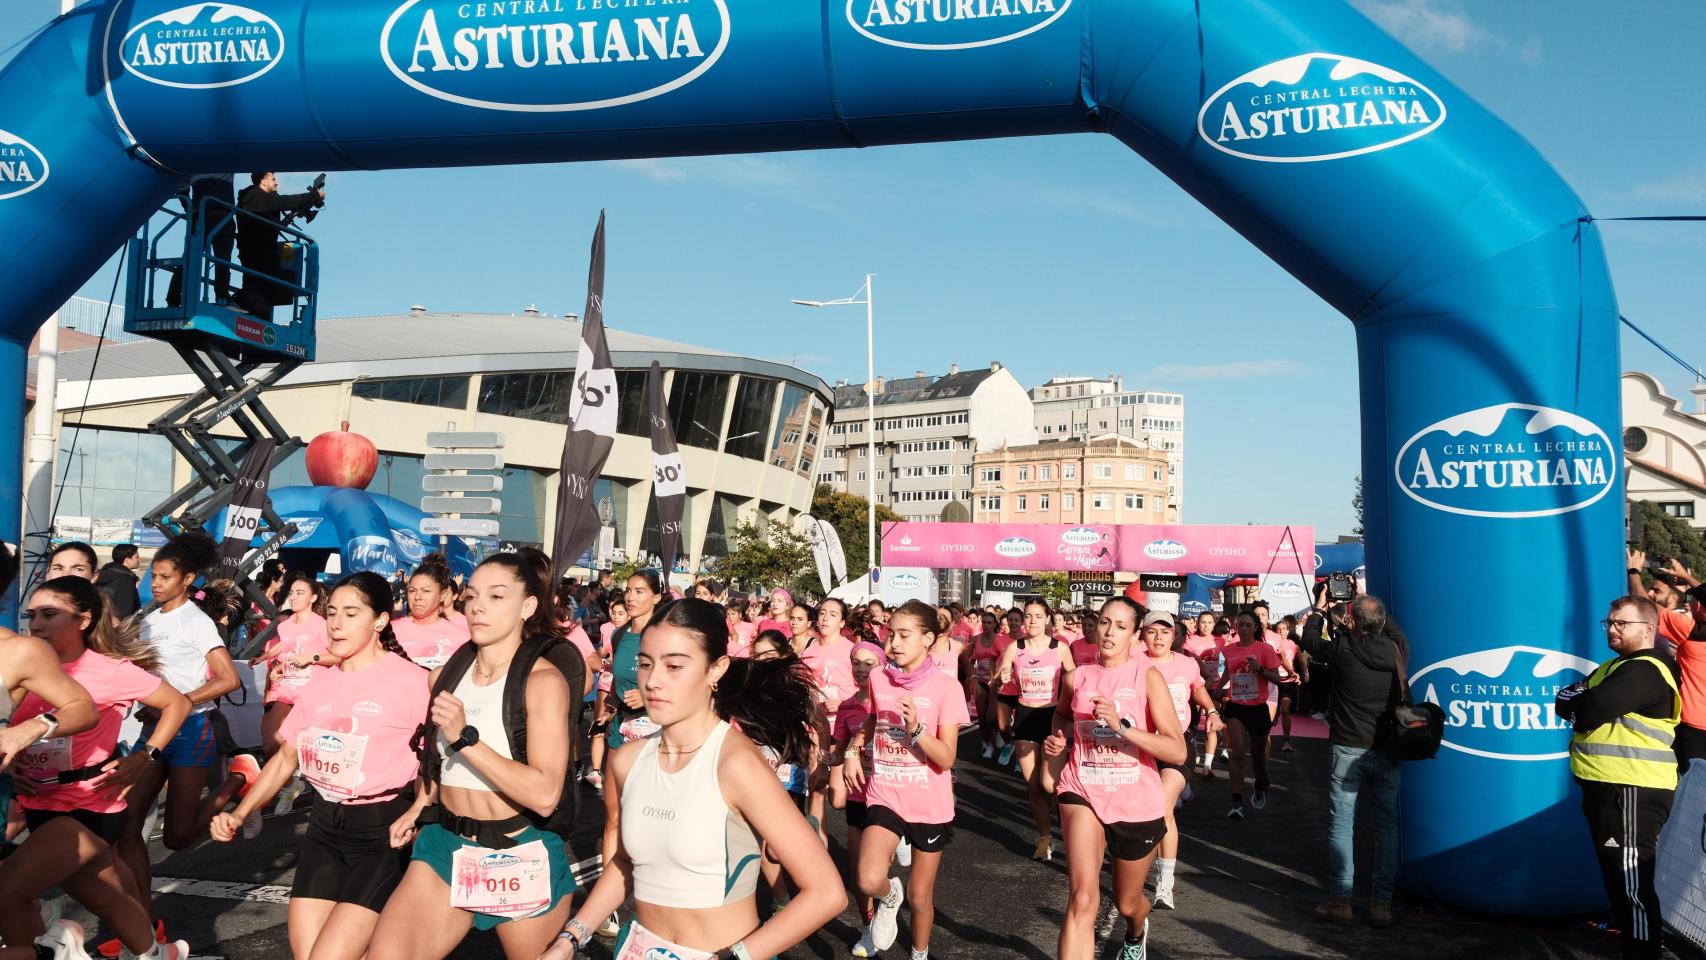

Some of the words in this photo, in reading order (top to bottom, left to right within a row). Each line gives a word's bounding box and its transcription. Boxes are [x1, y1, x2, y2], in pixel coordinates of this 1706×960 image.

[459, 0, 564, 18] CENTRAL
[157, 28, 208, 39] CENTRAL
[213, 26, 267, 36] LECHERA
[408, 9, 705, 72] ASTURIANA
[131, 32, 272, 66] ASTURIANA
[1250, 88, 1331, 106] CENTRAL
[1339, 86, 1418, 98] LECHERA
[1217, 100, 1432, 142] ASTURIANA
[1444, 442, 1525, 455] CENTRAL
[1534, 440, 1601, 452] LECHERA
[1410, 448, 1607, 488] ASTURIANA
[264, 547, 272, 557] 92
[998, 544, 1033, 552] ASTURIANA
[1146, 546, 1184, 554] ASTURIANA
[1208, 547, 1246, 556] OYSHO
[993, 580, 1026, 588] OYSHO
[1070, 582, 1112, 592] OYSHO
[1146, 580, 1182, 588] OYSHO
[1451, 683, 1532, 696] CENTRAL
[888, 746, 908, 755] 016
[1096, 746, 1118, 754] 016
[316, 760, 340, 774] 016
[642, 806, 676, 820] OYSHO
[486, 878, 520, 892] 016
